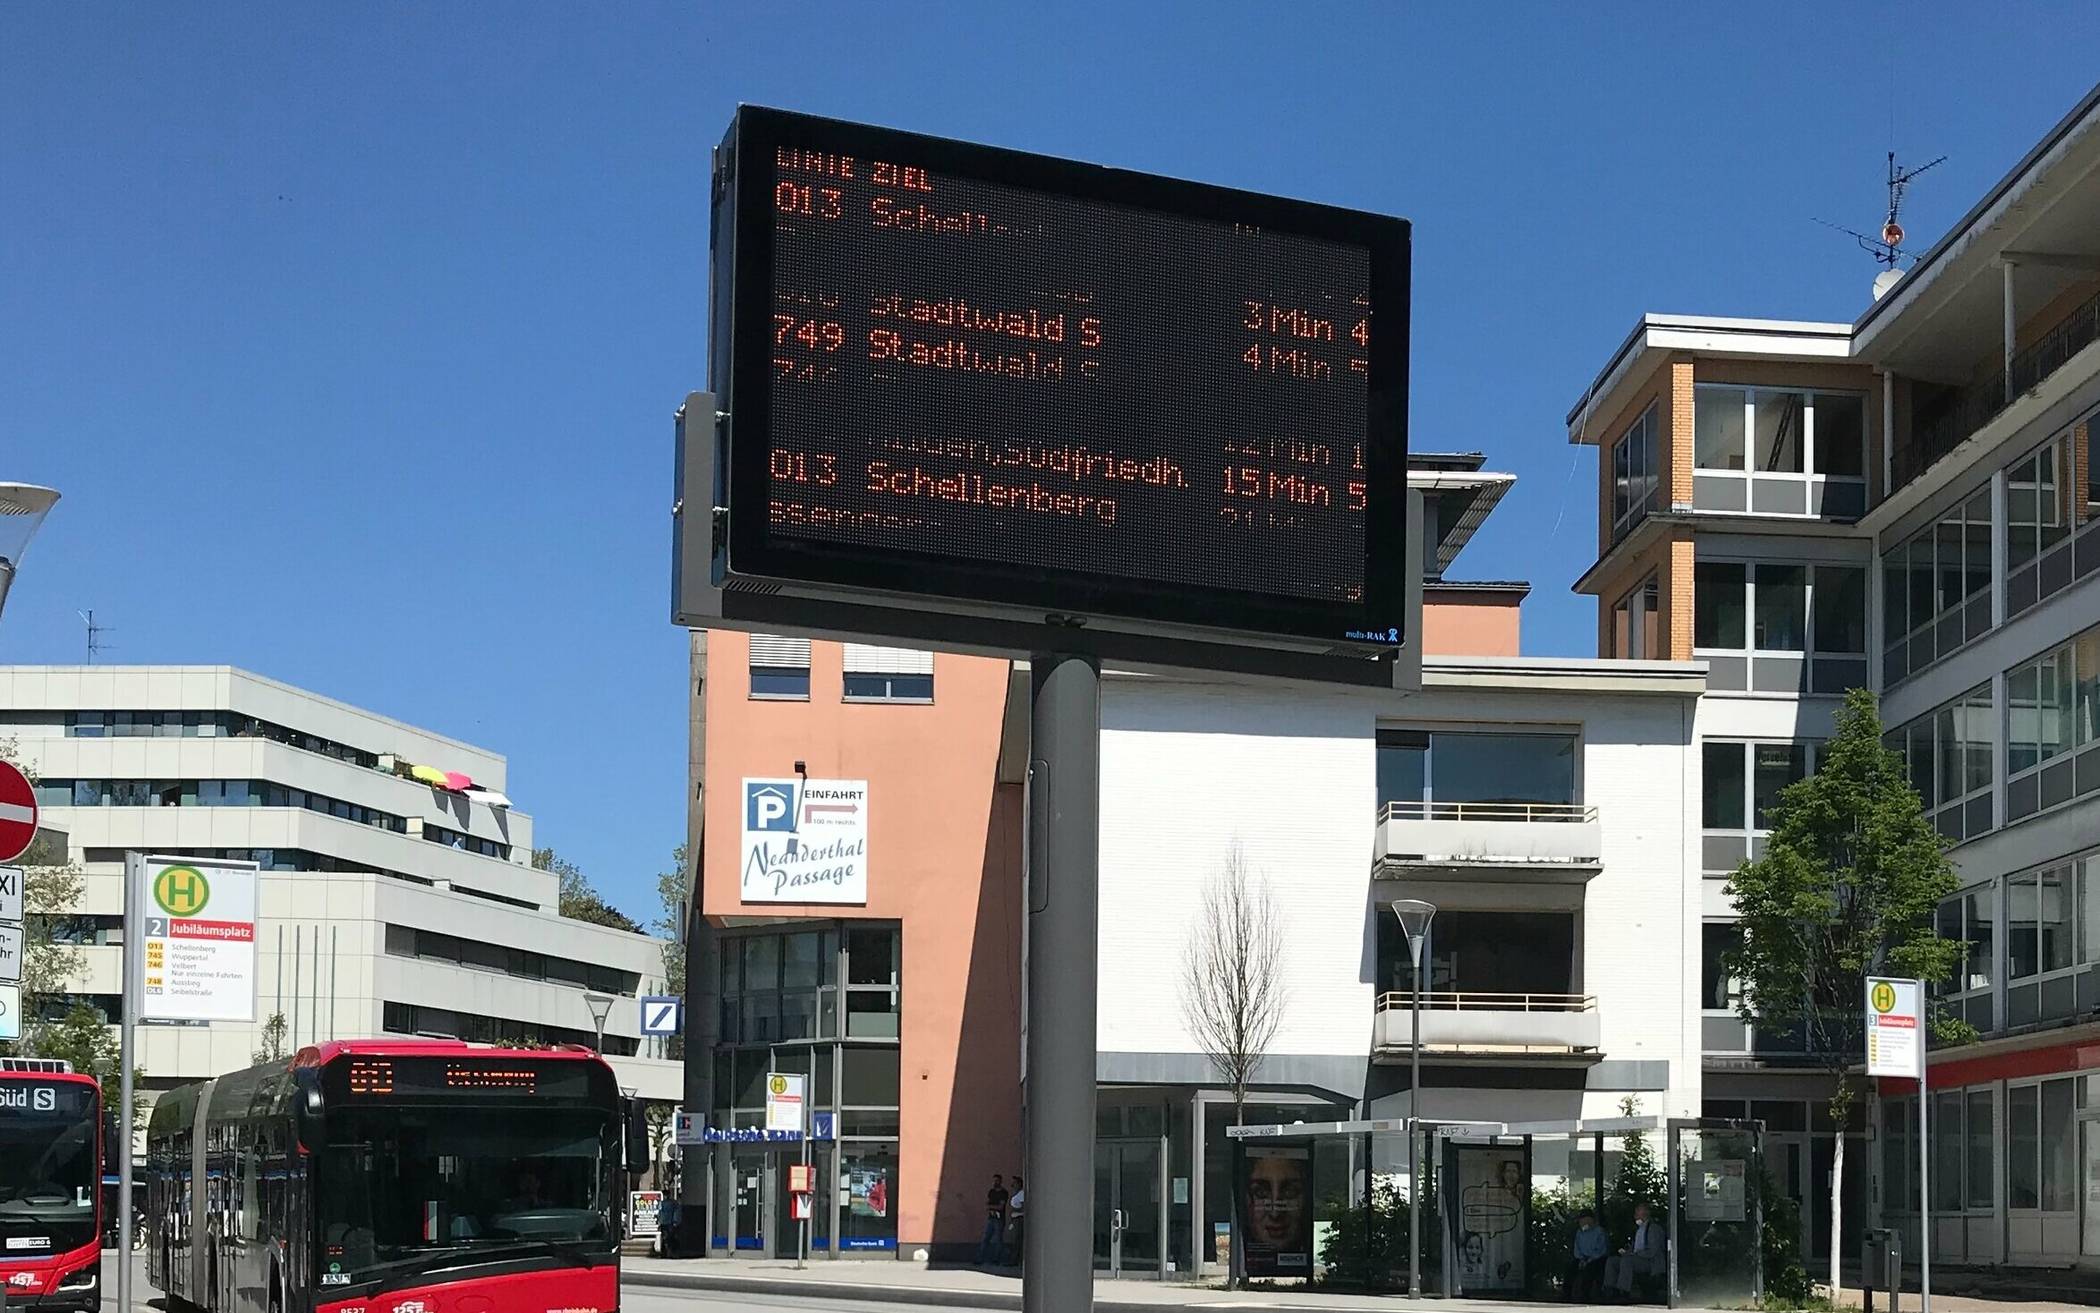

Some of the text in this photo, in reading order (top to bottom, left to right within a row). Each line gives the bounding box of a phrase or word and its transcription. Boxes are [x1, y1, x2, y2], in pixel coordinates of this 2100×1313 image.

[873, 161, 933, 192] ZIEL
[1081, 317, 1100, 347] S
[1243, 301, 1263, 330] 3
[1271, 304, 1332, 341] Min
[1351, 319, 1369, 347] 4
[773, 313, 844, 352] 749
[869, 328, 1063, 381] Stadtwald
[1243, 343, 1262, 371] 4
[1271, 346, 1331, 381] Min
[866, 461, 1117, 527] Schellenberg
[1223, 465, 1260, 497] 15
[1268, 471, 1329, 506] Min
[1348, 482, 1367, 510] 5
[804, 789, 864, 800] EINFAHRT
[757, 795, 787, 829] P
[835, 818, 856, 826] rechts
[744, 838, 863, 887] Neanderthal
[767, 863, 855, 896] Passage
[151, 919, 252, 939] 2 Jubiläumsplatz
[171, 944, 216, 953] Schellenberg
[1869, 1015, 1876, 1025] 3
